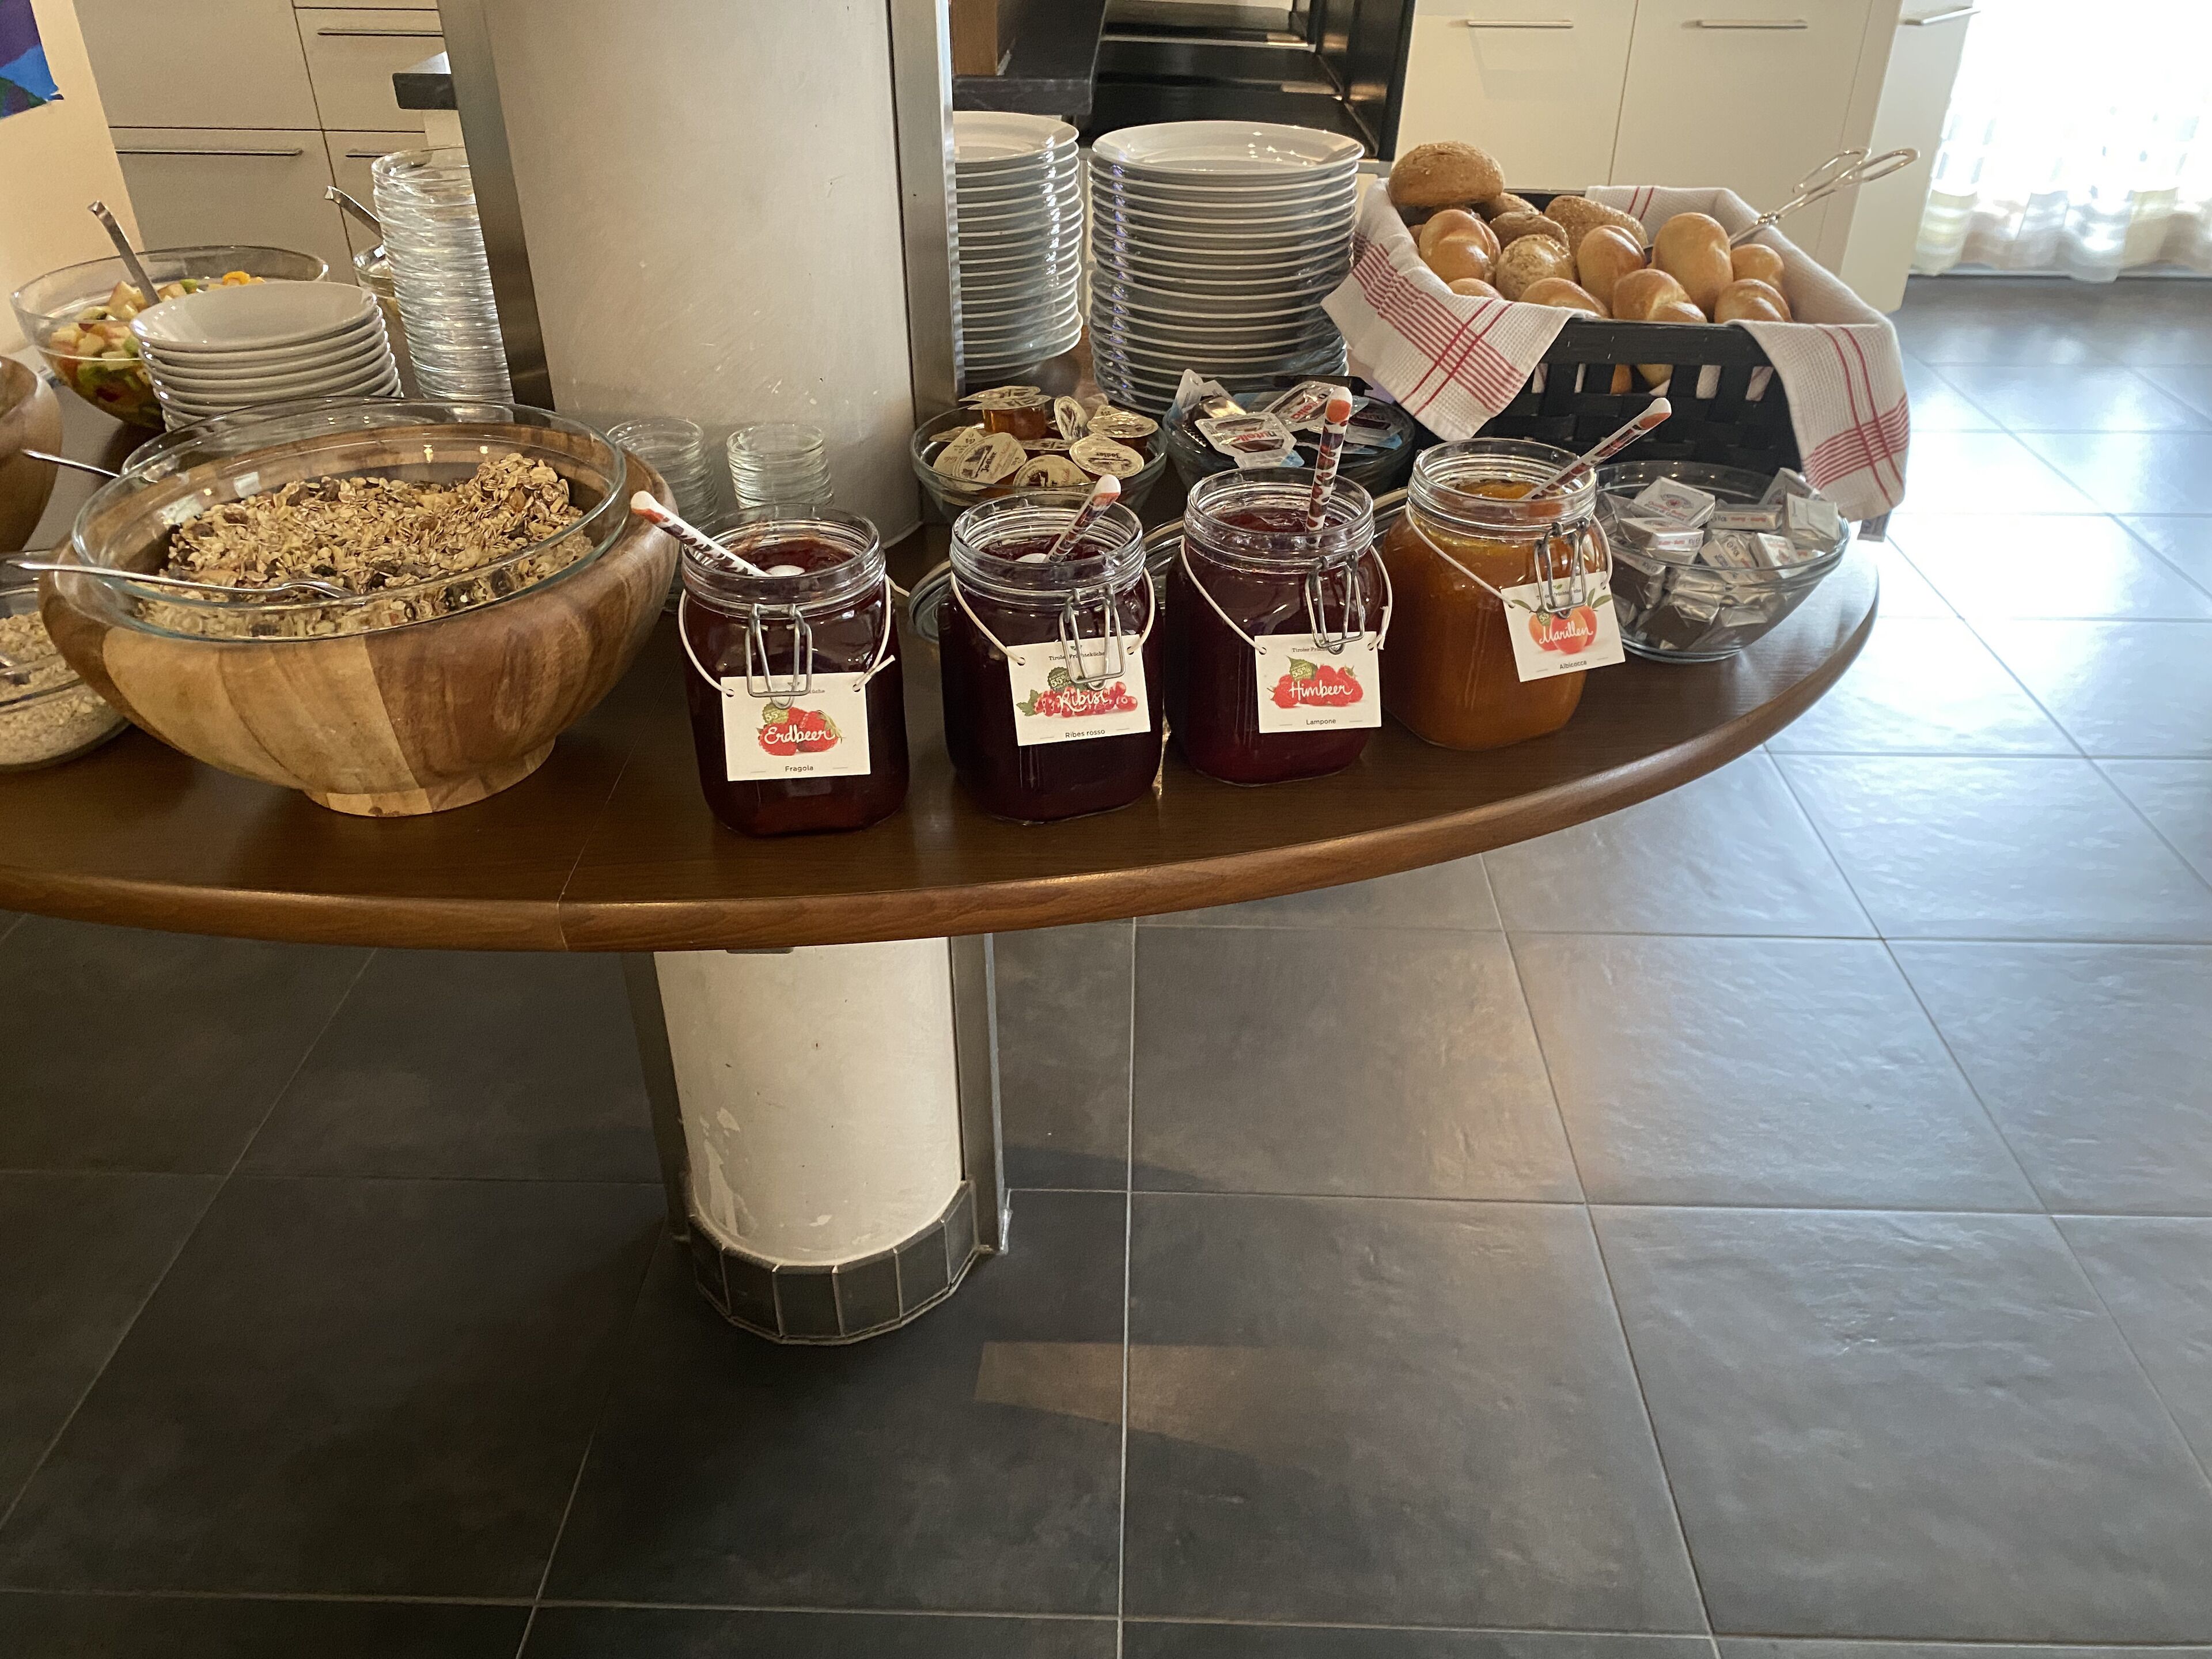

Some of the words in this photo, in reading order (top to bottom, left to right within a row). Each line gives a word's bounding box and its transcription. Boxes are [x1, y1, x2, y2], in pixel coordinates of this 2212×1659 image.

[1539, 620, 1594, 644] Marillen
[1291, 666, 1310, 678] 55%
[1559, 660, 1588, 670] Albicocca
[1288, 679, 1354, 700] Himbeer
[1056, 688, 1112, 712] Ribisl
[1306, 718, 1336, 726] Lampone
[764, 724, 836, 745] Erdbeer
[785, 764, 814, 773] Fragola
